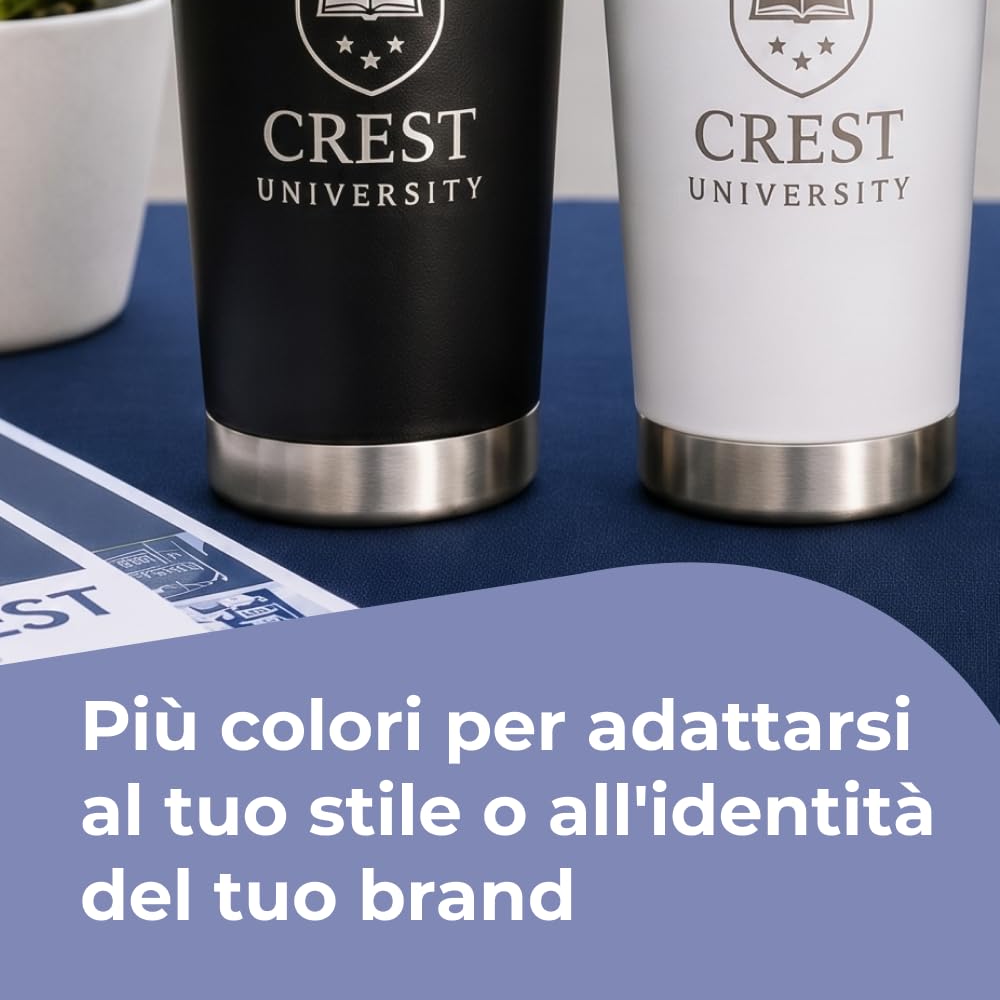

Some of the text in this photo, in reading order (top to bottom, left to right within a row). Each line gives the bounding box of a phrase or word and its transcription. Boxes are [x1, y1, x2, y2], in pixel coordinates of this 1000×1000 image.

[263, 107, 477, 164] CREST
[695, 109, 904, 164] CREST
[256, 176, 483, 207] UNIVERSITY
[688, 176, 910, 206] UNIVERSITY
